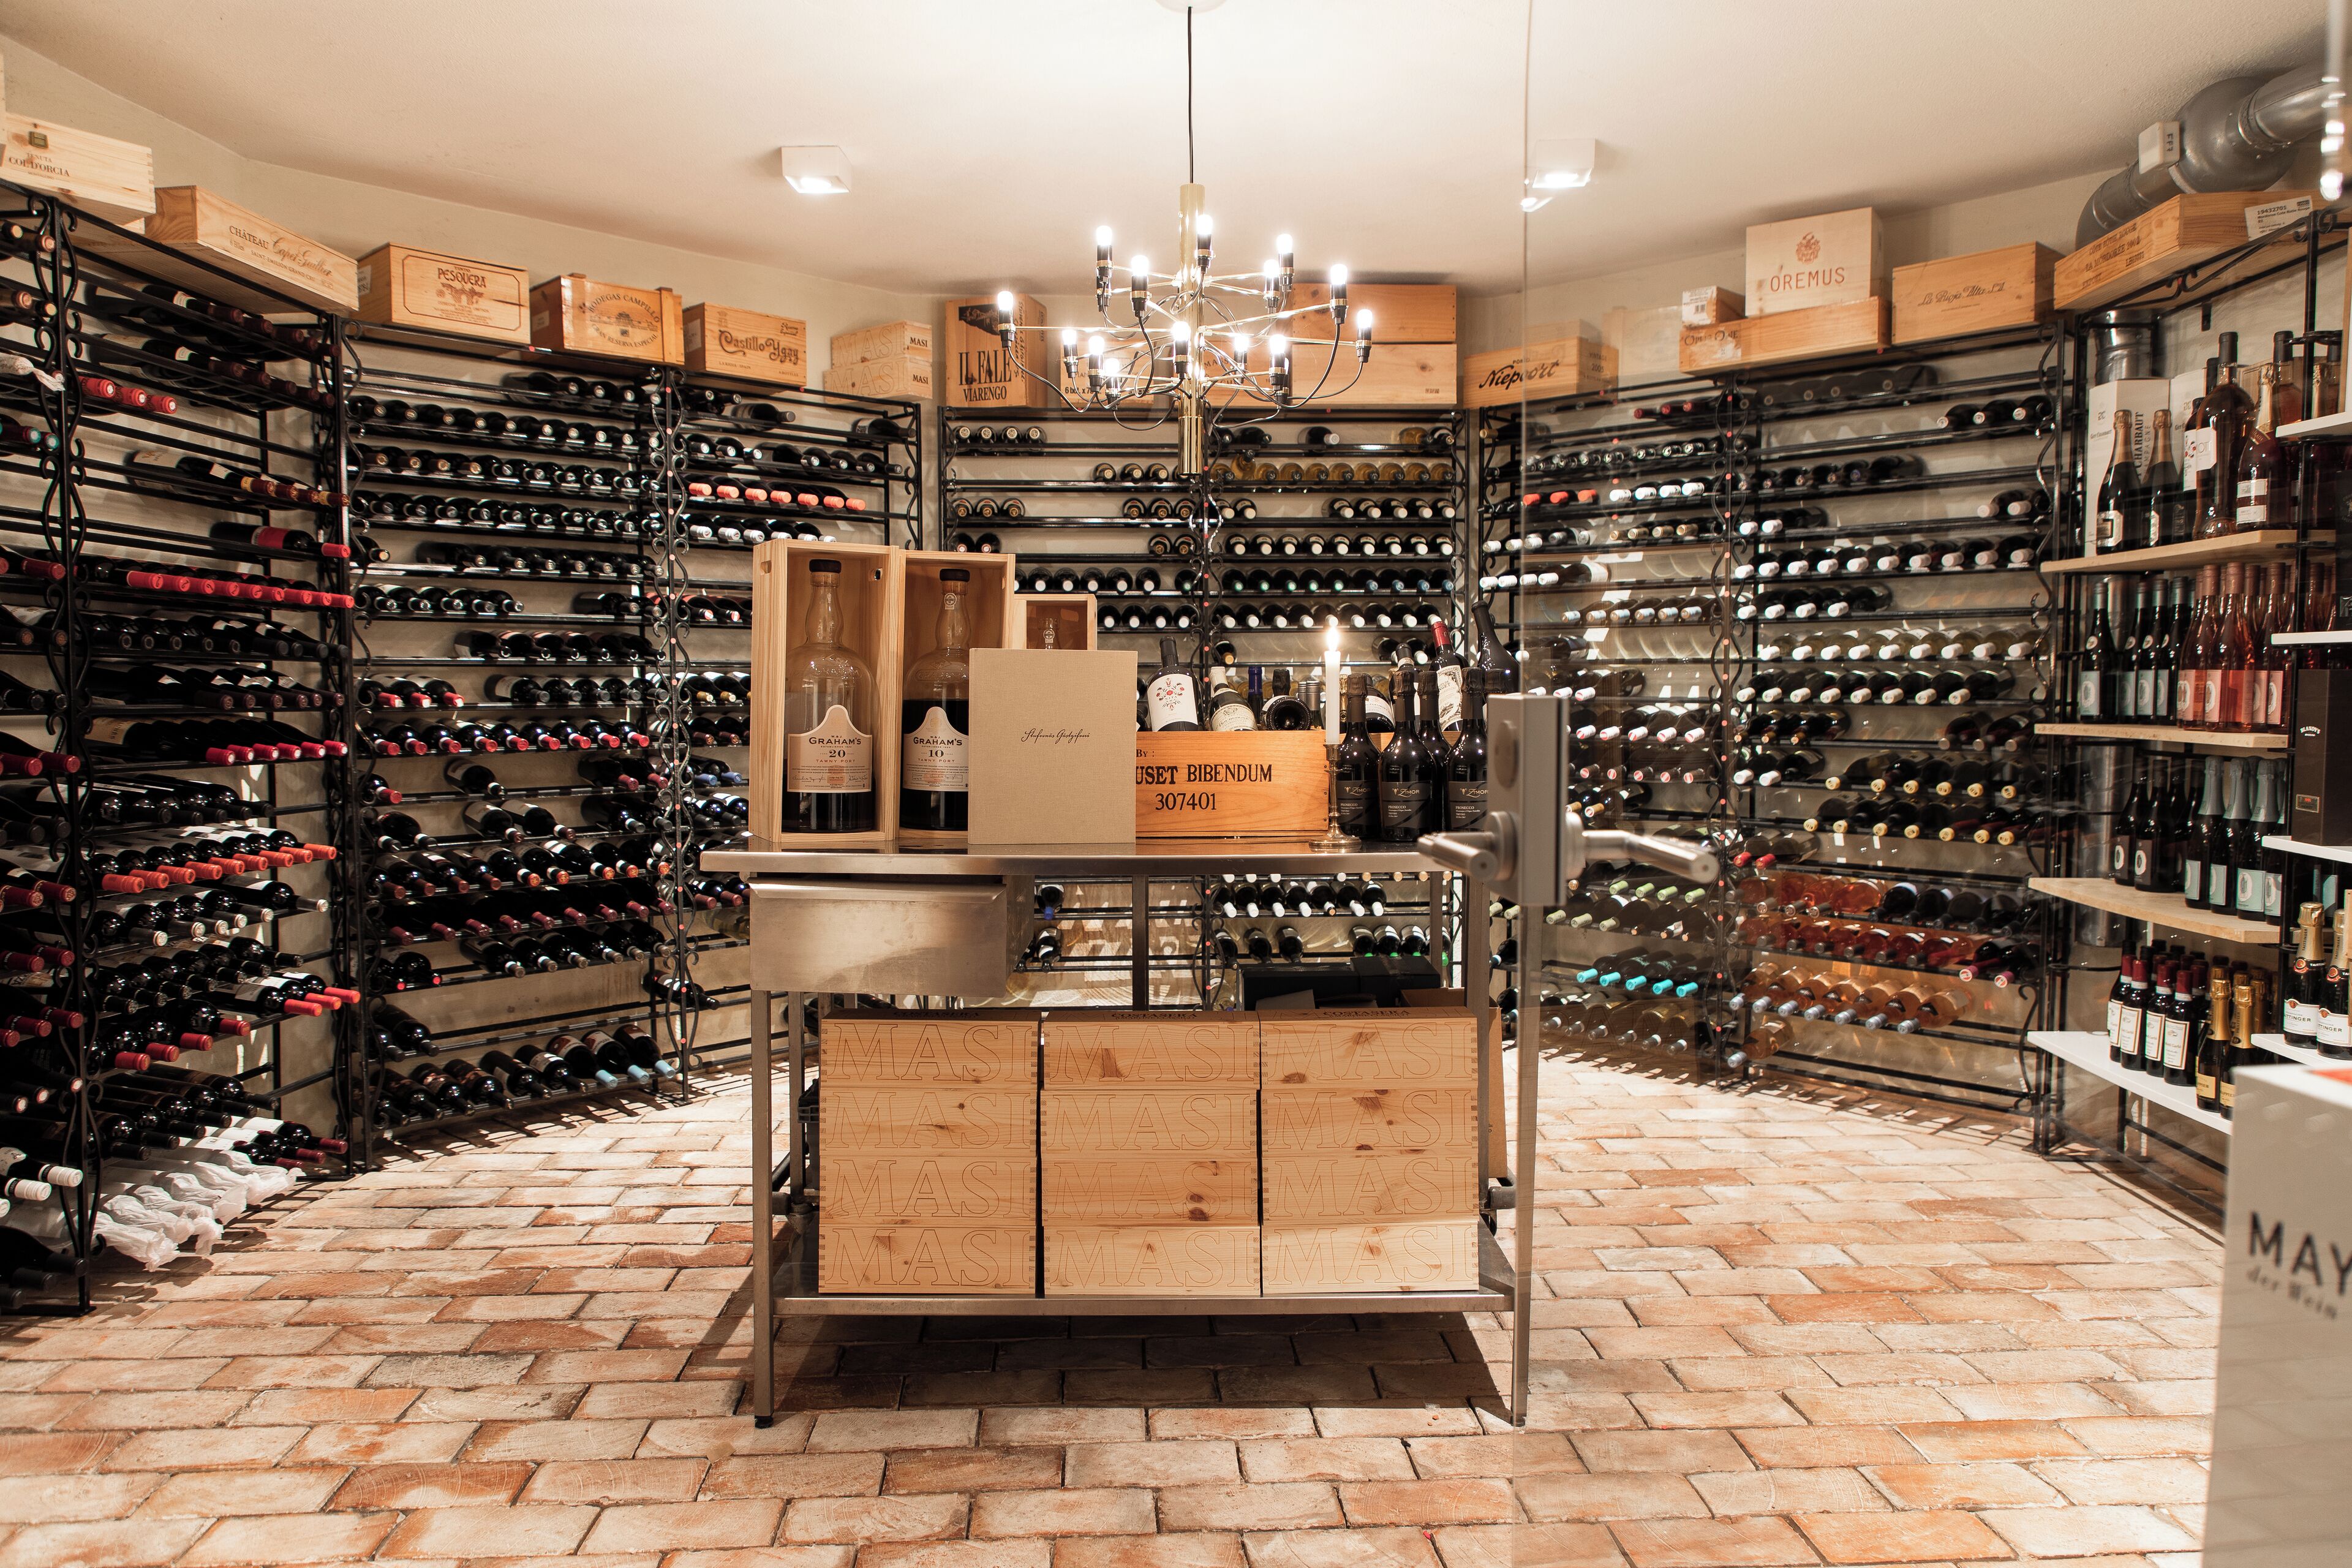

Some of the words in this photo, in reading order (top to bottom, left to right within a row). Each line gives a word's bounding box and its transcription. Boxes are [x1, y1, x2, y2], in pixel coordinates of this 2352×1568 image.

[9, 157, 29, 168] COL
[29, 161, 70, 176] D'ORCIA
[24, 153, 53, 163] TENUTA
[229, 225, 270, 250] CHÂTEAU
[437, 267, 487, 288] PESQUERA
[587, 293, 621, 314] BODEGAS
[623, 294, 660, 323] CAMPILLO
[591, 323, 607, 339] GRAN
[607, 336, 634, 348] RESERVA
[633, 333, 659, 348] ESPECIAL
[718, 329, 765, 358] Castillo
[765, 337, 799, 366] Ygay
[835, 325, 905, 368] MASI
[910, 336, 928, 348] MASI
[829, 358, 908, 399] MASI
[912, 374, 929, 385] MASI
[959, 351, 975, 386] IL
[976, 348, 1012, 385] FALE
[963, 385, 1008, 403] VIARENGO
[809, 736, 862, 745] GRAHAM'S
[829, 749, 846, 758] 20
[913, 736, 963, 746] GRAHAM'S
[929, 749, 944, 758] 10
[1136, 765, 1178, 785] USET
[1186, 764, 1273, 783] BIBENDUM
[1155, 792, 1217, 811] 307401
[827, 1023, 1032, 1082] MASI
[1050, 1025, 1254, 1084] MASI
[1267, 1022, 1472, 1084] MASI
[826, 1091, 1031, 1150] MASI
[1047, 1093, 1250, 1153] MASI
[1267, 1090, 1472, 1150] MASI
[826, 1159, 1031, 1218] MASI
[1048, 1161, 1251, 1220] MASI
[1268, 1157, 1473, 1218] MASI
[825, 1228, 1030, 1287] MASI
[1050, 1230, 1254, 1289] MASI
[1268, 1226, 1473, 1287] MASI
